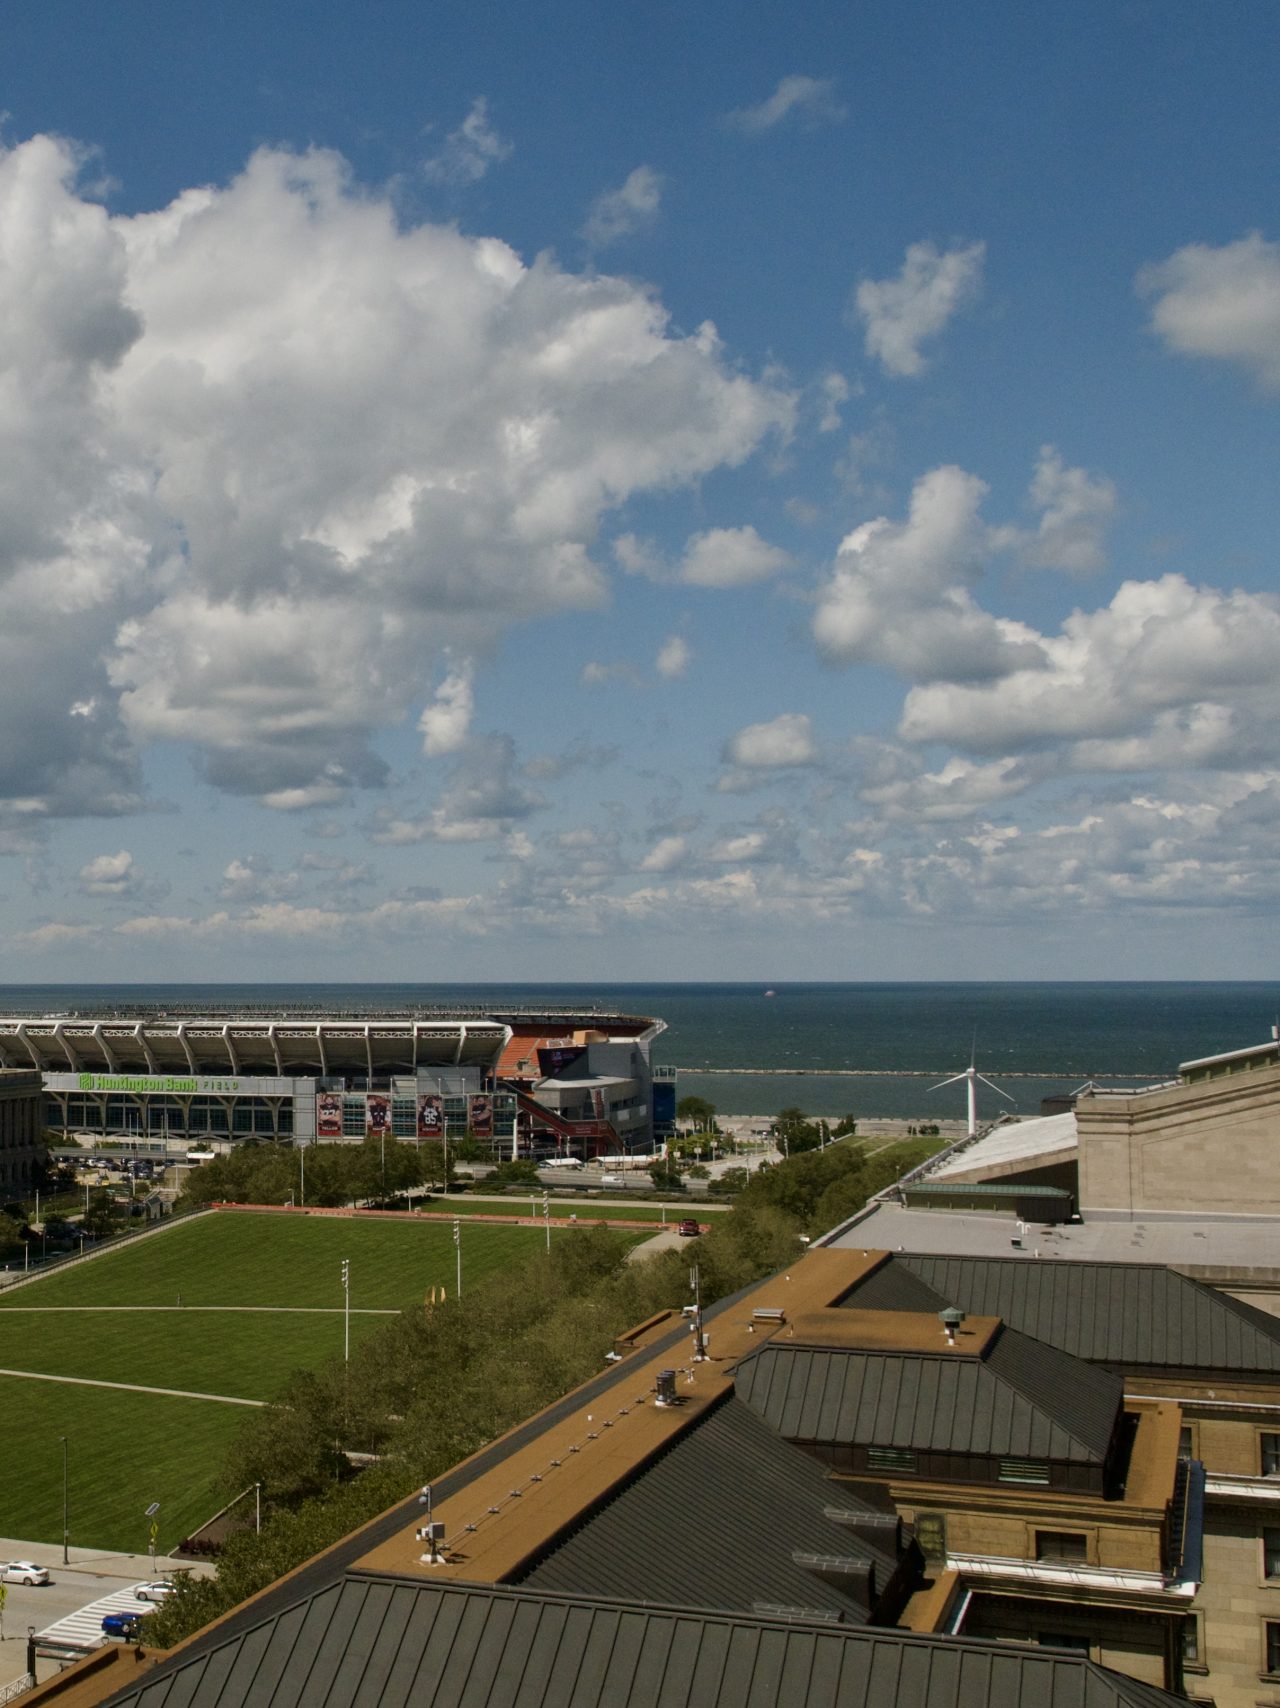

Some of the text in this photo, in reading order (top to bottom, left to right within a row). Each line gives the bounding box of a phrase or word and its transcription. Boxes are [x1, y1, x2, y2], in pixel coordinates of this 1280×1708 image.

[95, 1074, 239, 1093] Huntington Bank FIELD
[424, 1114, 437, 1125] 85
